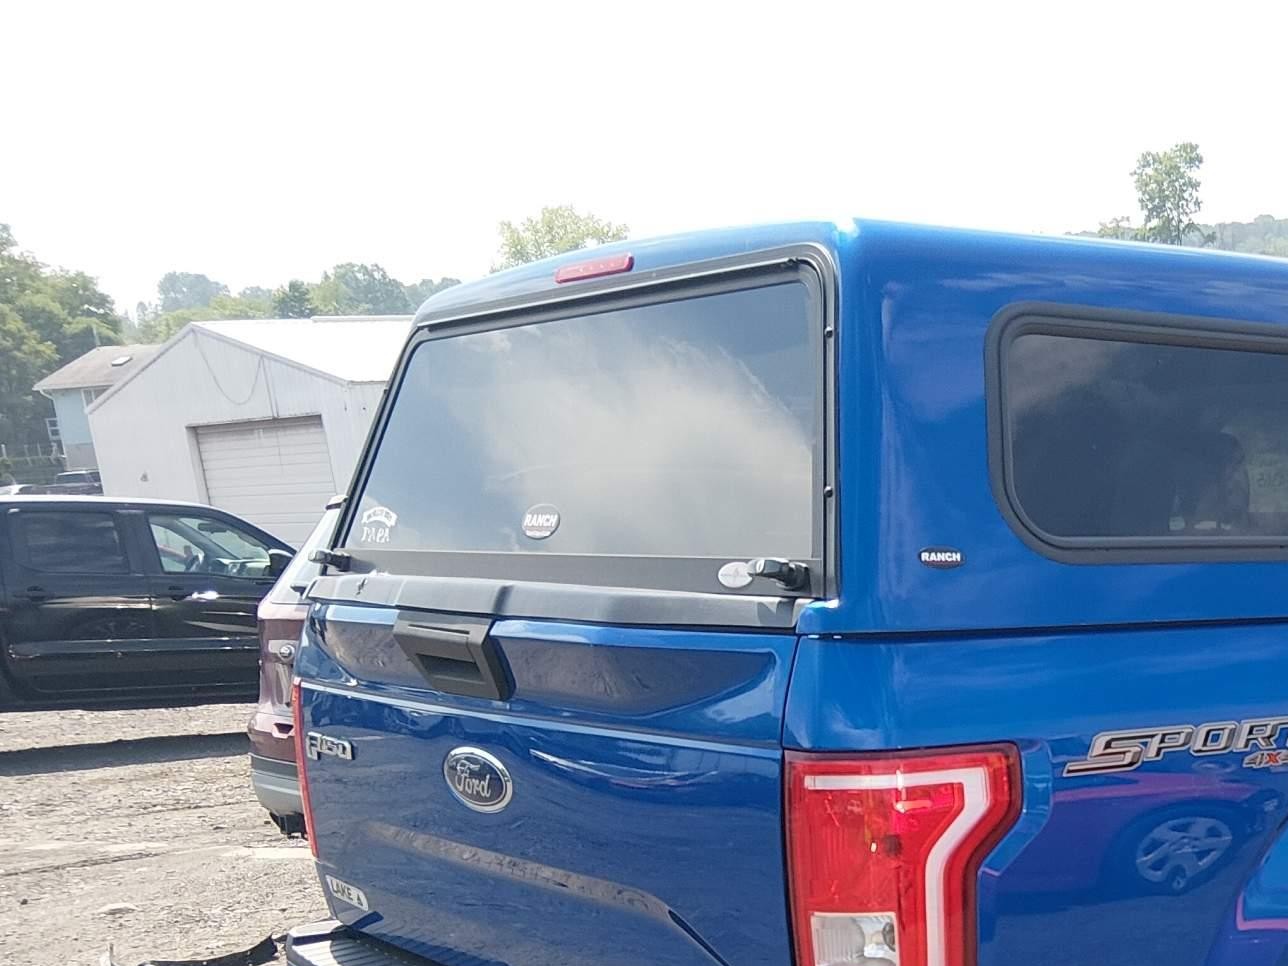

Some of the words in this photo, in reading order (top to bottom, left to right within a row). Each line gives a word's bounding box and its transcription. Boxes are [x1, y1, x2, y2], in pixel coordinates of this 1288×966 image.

[523, 514, 557, 527] RANCH
[920, 551, 962, 562] RANCH
[451, 758, 492, 799] Ford
